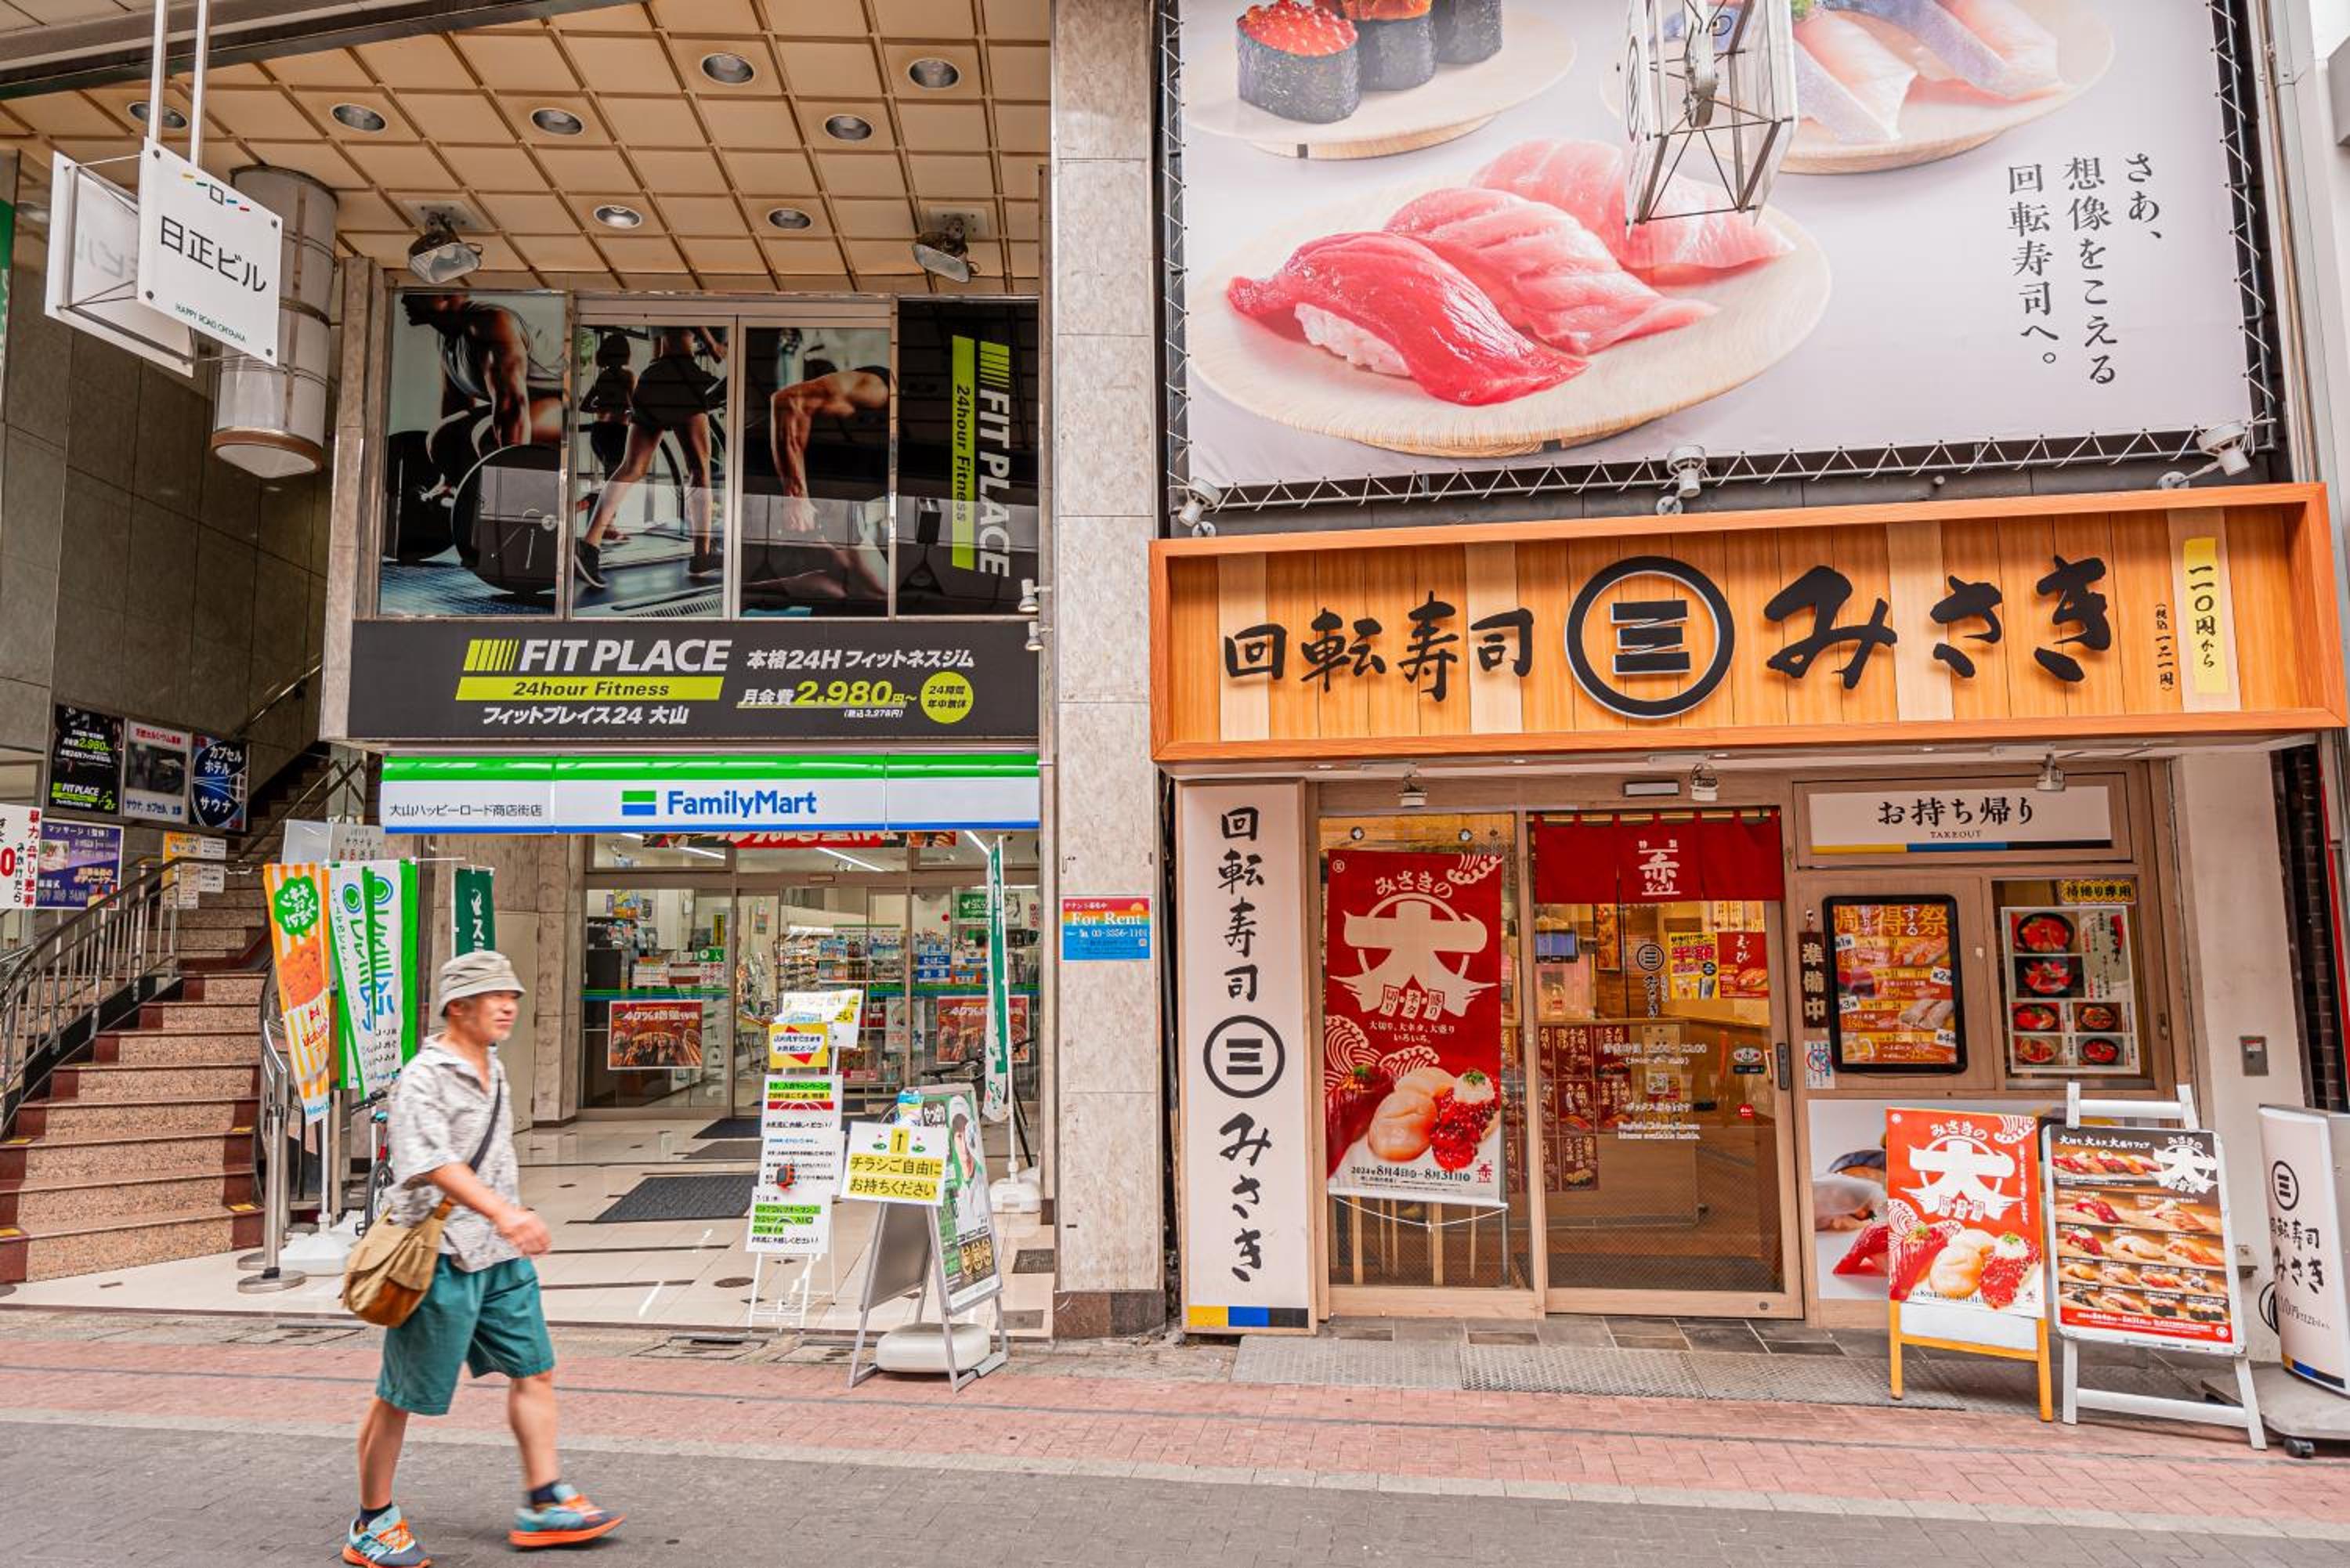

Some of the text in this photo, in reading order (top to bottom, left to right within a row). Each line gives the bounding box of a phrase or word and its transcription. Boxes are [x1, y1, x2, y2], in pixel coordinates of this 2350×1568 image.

[2126, 153, 2162, 239] さあ、
[161, 215, 267, 293] 日正ビル
[2007, 163, 2059, 364] 回転寿司へ。
[2062, 157, 2118, 384] 想像をこえる
[956, 384, 971, 522] 24hour Fitness
[978, 388, 1010, 577] FIT PLACE
[1762, 555, 2113, 690] みさき
[519, 639, 732, 672] FIT PLACE
[1224, 589, 1535, 703] 回転寿司
[513, 681, 670, 697] 24hour Fitness
[928, 685, 966, 695] 24時間
[483, 705, 690, 725] フィットプレイス24 大山
[926, 699, 967, 710] 年中無休
[204, 761, 231, 776] ホテル
[209, 745, 243, 764] カプセル
[200, 796, 233, 815] サウナ
[389, 803, 544, 818] 大山ハッピーロード商店街店
[667, 790, 818, 818] FamilyMart
[1878, 796, 2034, 826] お持ち帰り
[1375, 870, 1454, 899] みさきの
[1072, 911, 1141, 926] For Rent
[1216, 806, 1265, 1003] 回転寿司
[1802, 942, 1827, 1021] 準備中
[850, 1157, 942, 1176] チラシご自由に
[849, 1177, 938, 1198] お持ちください
[1218, 1111, 1273, 1283] みさき
[2273, 1245, 2325, 1295] みさき
